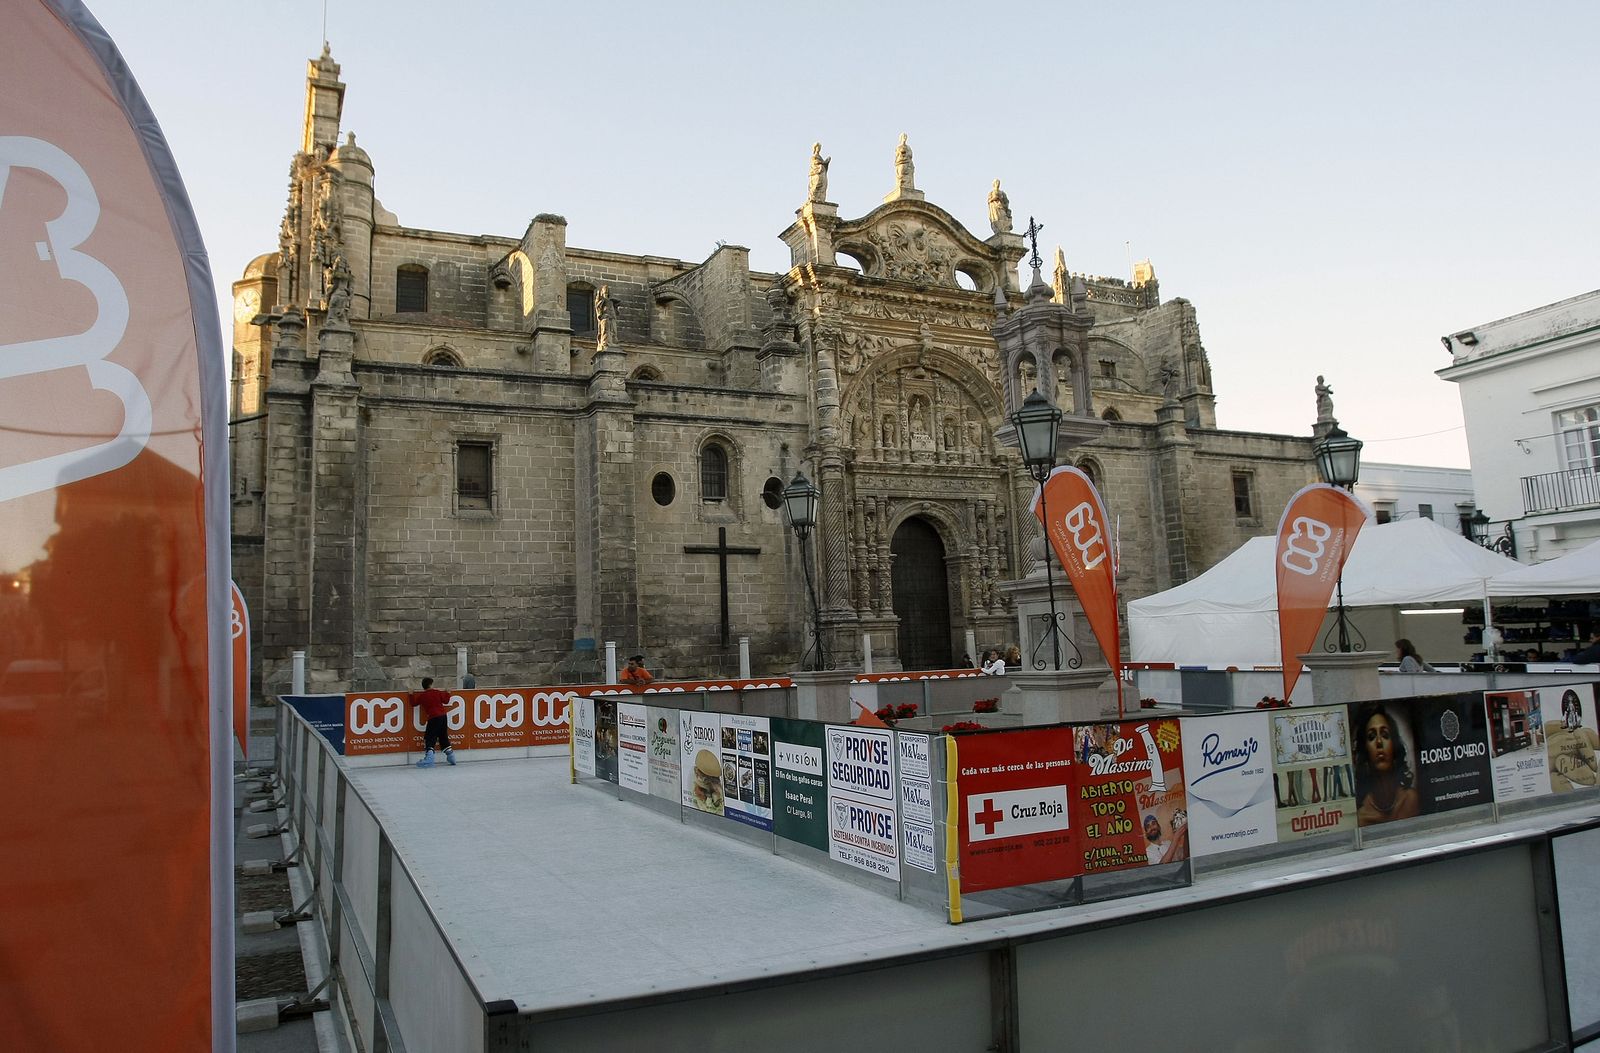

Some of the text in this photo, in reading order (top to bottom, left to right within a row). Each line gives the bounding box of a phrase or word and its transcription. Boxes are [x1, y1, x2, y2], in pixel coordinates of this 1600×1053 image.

[900, 736, 928, 744] TRANSPORTES
[1113, 737, 1133, 756] Da
[786, 752, 817, 767] VISIÓN
[846, 736, 888, 766] PROYSE
[901, 742, 927, 761] M&Vaca
[1197, 733, 1258, 773] Romerijo
[1420, 742, 1486, 765] FLORES JOYERO
[962, 767, 978, 776] Cada
[992, 764, 1005, 772] más
[1046, 759, 1071, 770] personas
[1088, 753, 1154, 776] Massimo
[798, 775, 810, 785] gafas
[832, 761, 890, 790] SEGURIDAD
[902, 780, 929, 790] TRANSPORTES
[785, 790, 813, 805] Isaac Peral
[903, 786, 930, 807] M&Vaca
[1139, 790, 1185, 810] Massimo
[1011, 800, 1063, 820] Cruz Roja
[1091, 802, 1126, 817] TODO
[850, 806, 892, 840] PROYSE
[1086, 815, 1133, 838] EL AÑO
[1291, 806, 1343, 833] cóndor
[905, 823, 932, 836] TRANSPORTES
[1211, 827, 1259, 841] www.romerijo.com
[834, 829, 894, 854] SISTEMAS CONTRA INCENDIOS
[905, 830, 933, 853] M&Vaca
[1123, 845, 1133, 854] 22
[854, 855, 864, 865] 956
[866, 860, 876, 869] 858
[878, 864, 890, 873] 290
